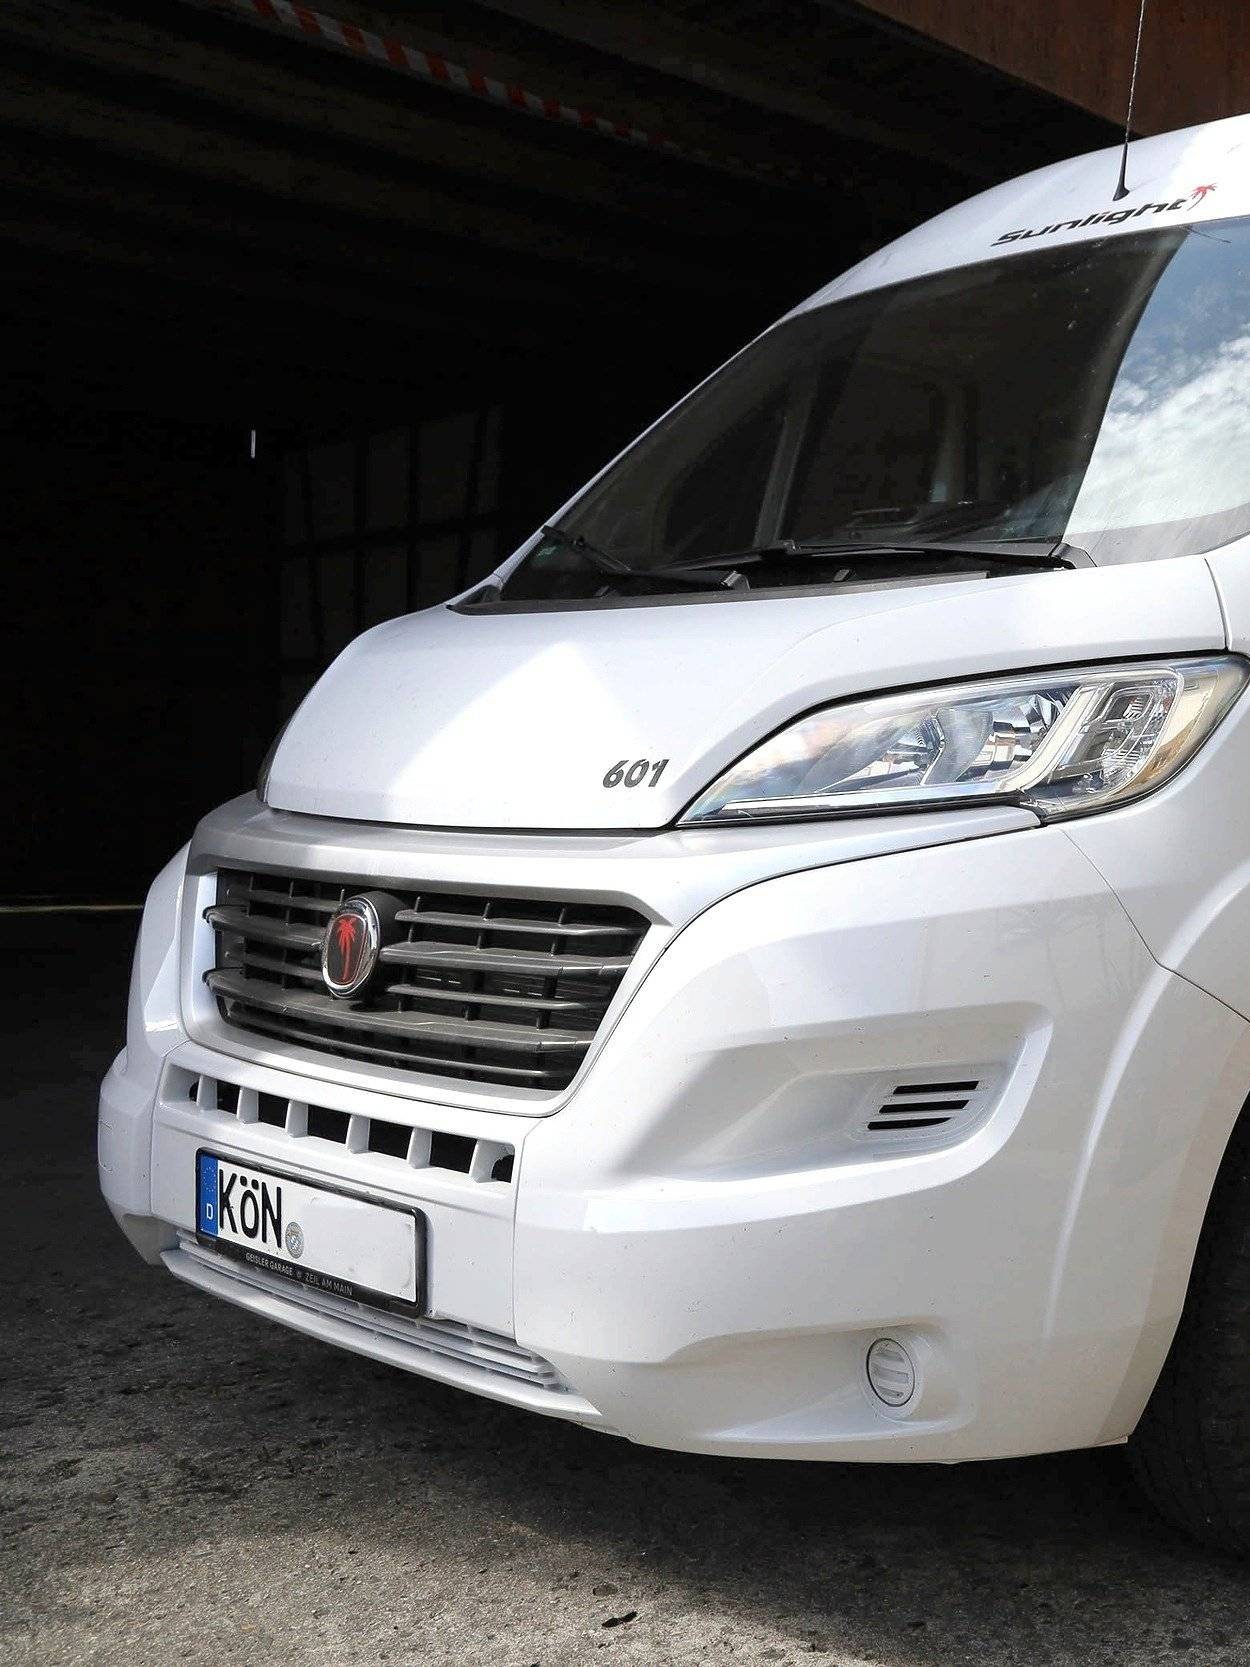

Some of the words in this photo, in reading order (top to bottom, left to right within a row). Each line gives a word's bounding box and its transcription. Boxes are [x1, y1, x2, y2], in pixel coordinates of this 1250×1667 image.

[990, 198, 1187, 246] Sunlight
[603, 759, 670, 788] 601
[206, 1203, 214, 1220] D
[219, 1169, 282, 1248] KÖN
[245, 1252, 269, 1267] GEISLER
[269, 1261, 293, 1276] GARAGE
[305, 1272, 320, 1286] ZEIL
[321, 1278, 333, 1290] AM
[333, 1281, 353, 1297] MAIN
